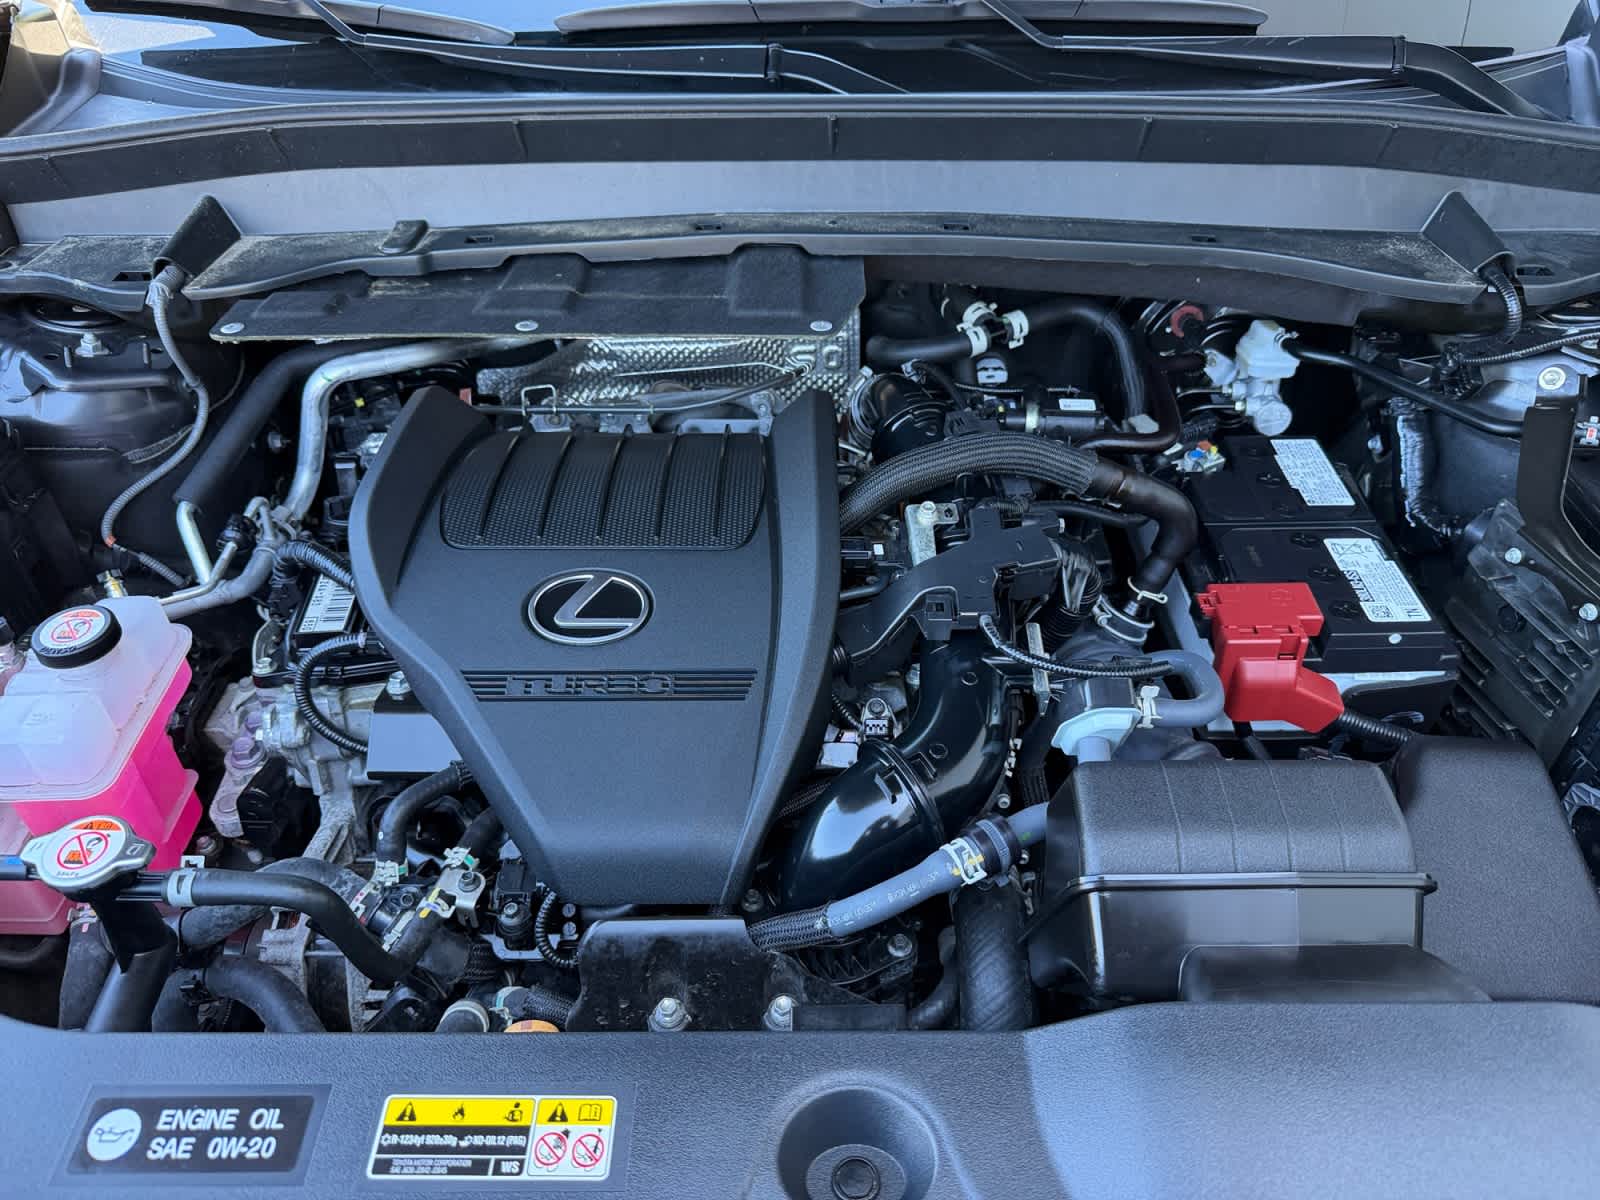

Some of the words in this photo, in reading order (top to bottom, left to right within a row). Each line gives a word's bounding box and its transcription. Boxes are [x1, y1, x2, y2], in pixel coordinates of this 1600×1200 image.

[505, 674, 675, 696] TURBO
[156, 1108, 240, 1131] ENGINE
[249, 1108, 285, 1131] OIL
[147, 1136, 196, 1159] SAE
[207, 1136, 276, 1160] 0W-20
[500, 1160, 521, 1174] WS
